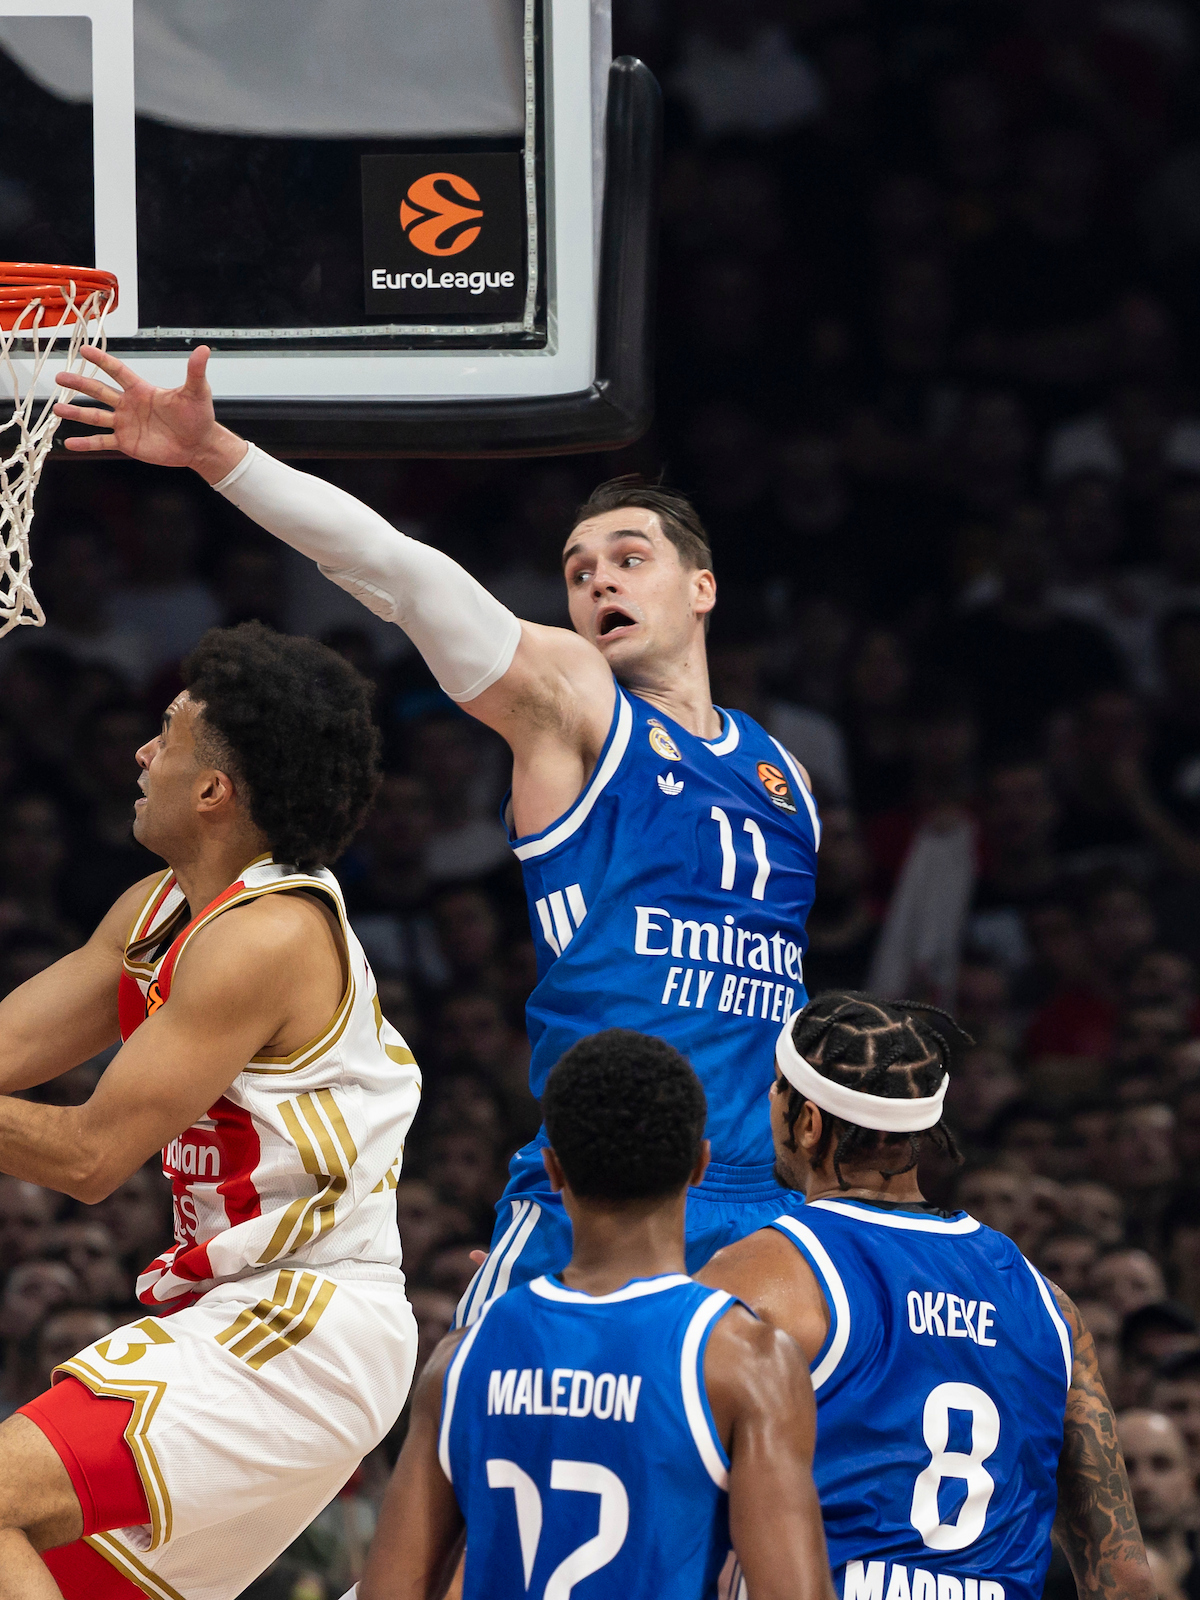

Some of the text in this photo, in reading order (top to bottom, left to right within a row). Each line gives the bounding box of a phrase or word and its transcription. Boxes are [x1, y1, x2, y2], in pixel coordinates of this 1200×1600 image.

[371, 268, 515, 295] EuroLeague
[710, 806, 771, 901] 11
[634, 905, 804, 984] Emirates
[661, 966, 795, 1024] FLY BETTER
[161, 1134, 220, 1177] idian
[906, 1290, 998, 1347] OKEKE
[487, 1367, 642, 1423] MALEDON
[910, 1381, 1000, 1550] 8
